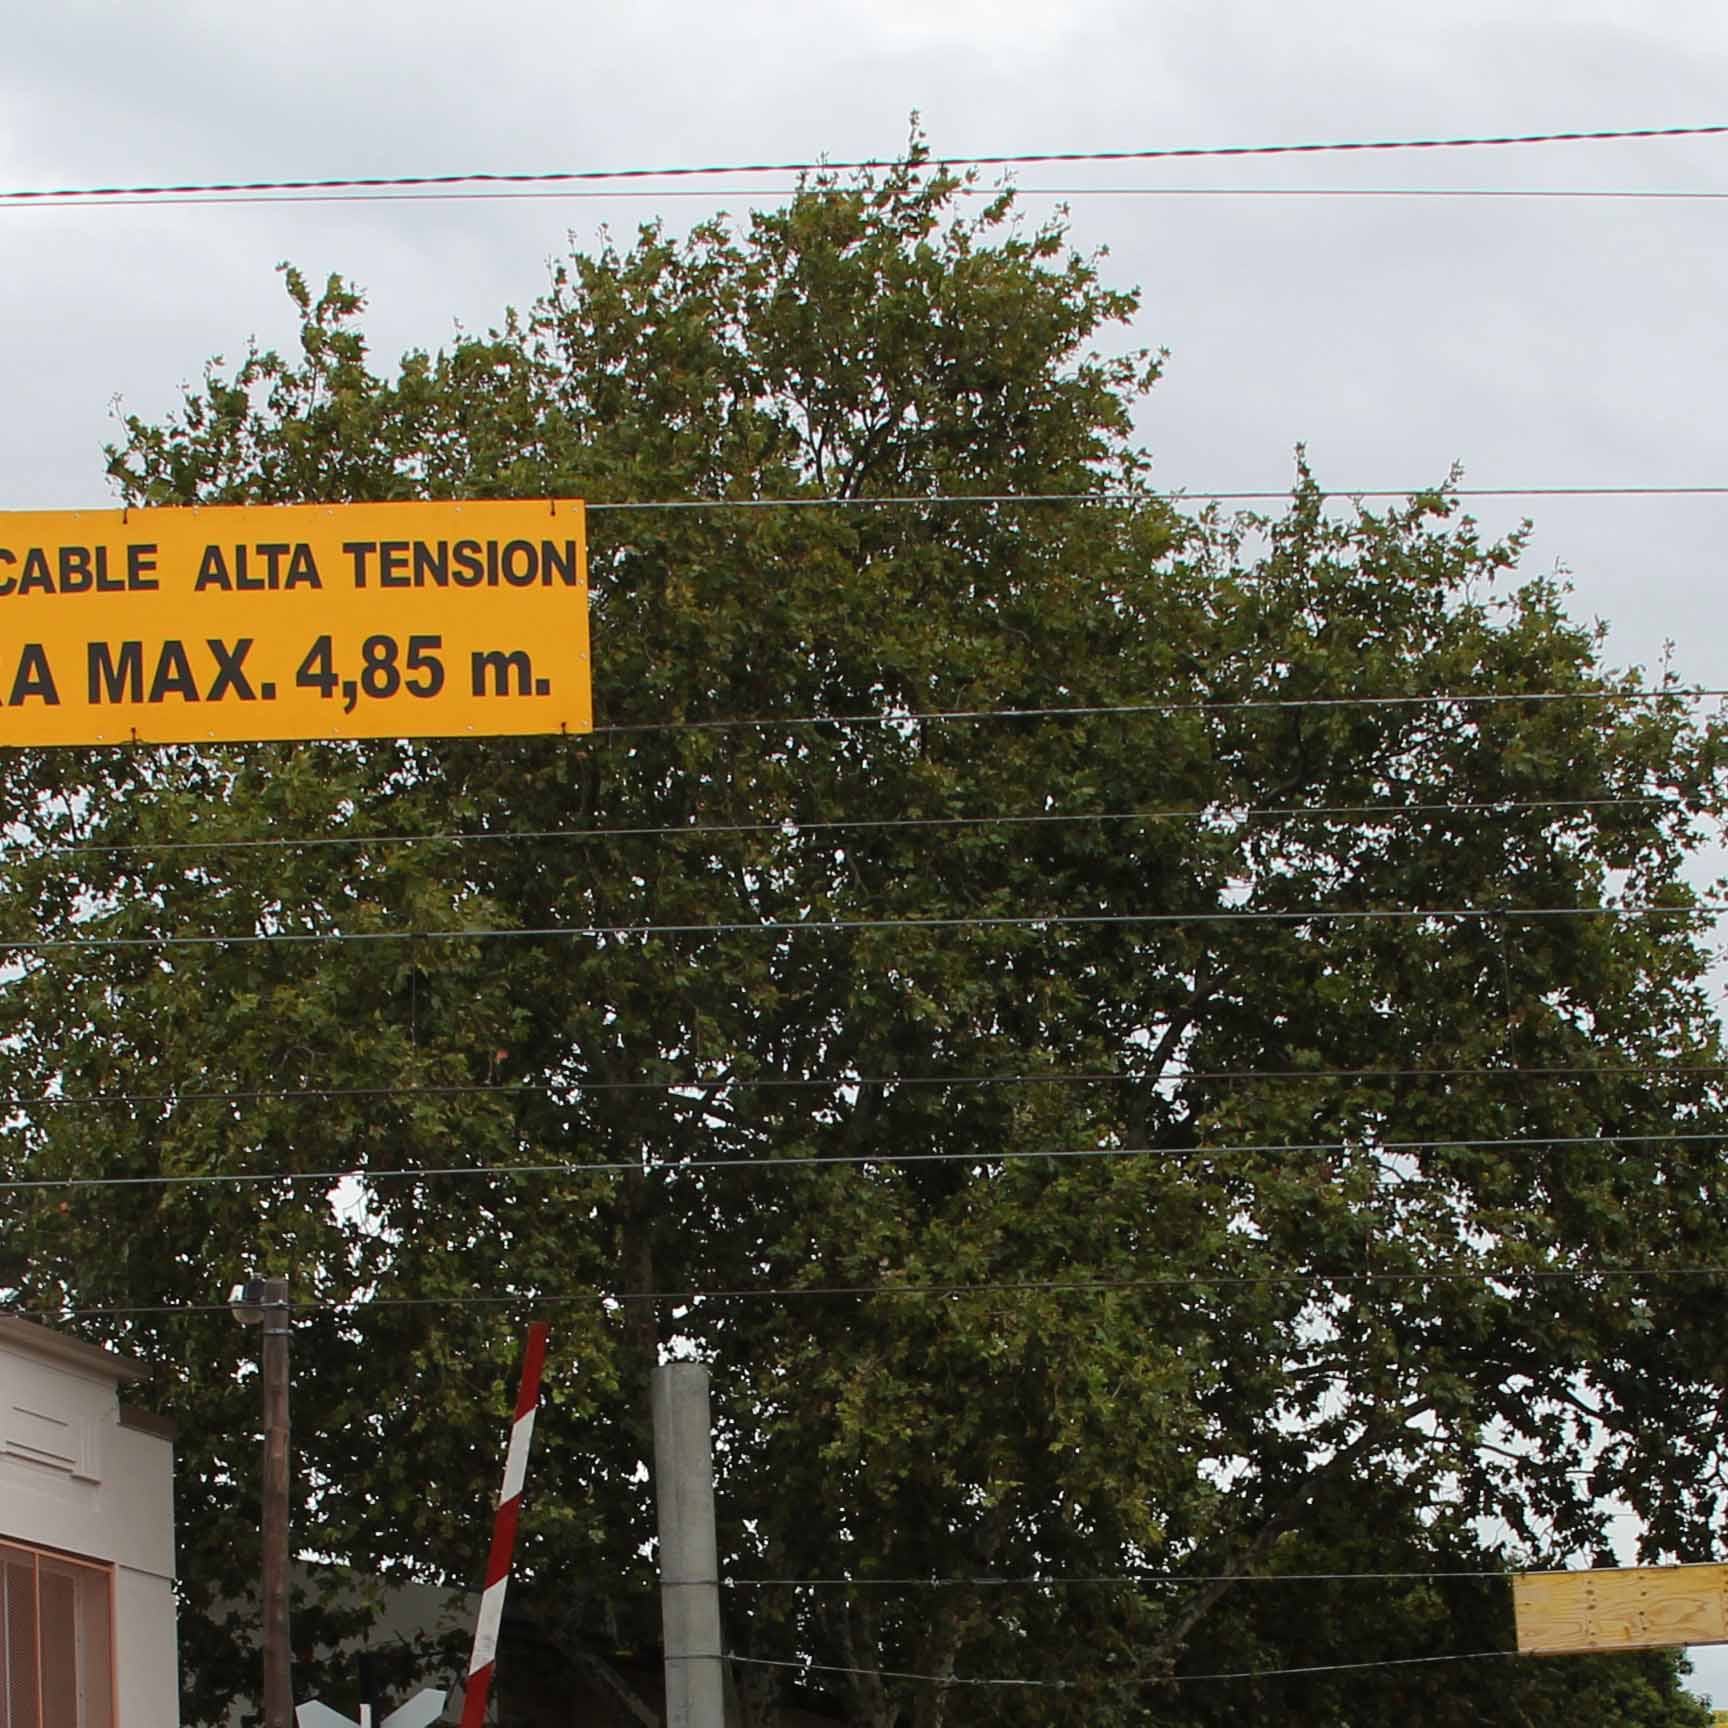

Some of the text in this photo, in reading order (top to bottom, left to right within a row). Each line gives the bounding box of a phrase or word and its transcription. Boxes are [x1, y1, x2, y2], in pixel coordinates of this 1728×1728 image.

[194, 542, 322, 592] ALTA
[342, 538, 578, 589] TENSION
[87, 638, 277, 705] MAX.
[294, 634, 446, 715] 4,85
[470, 649, 552, 697] m.
